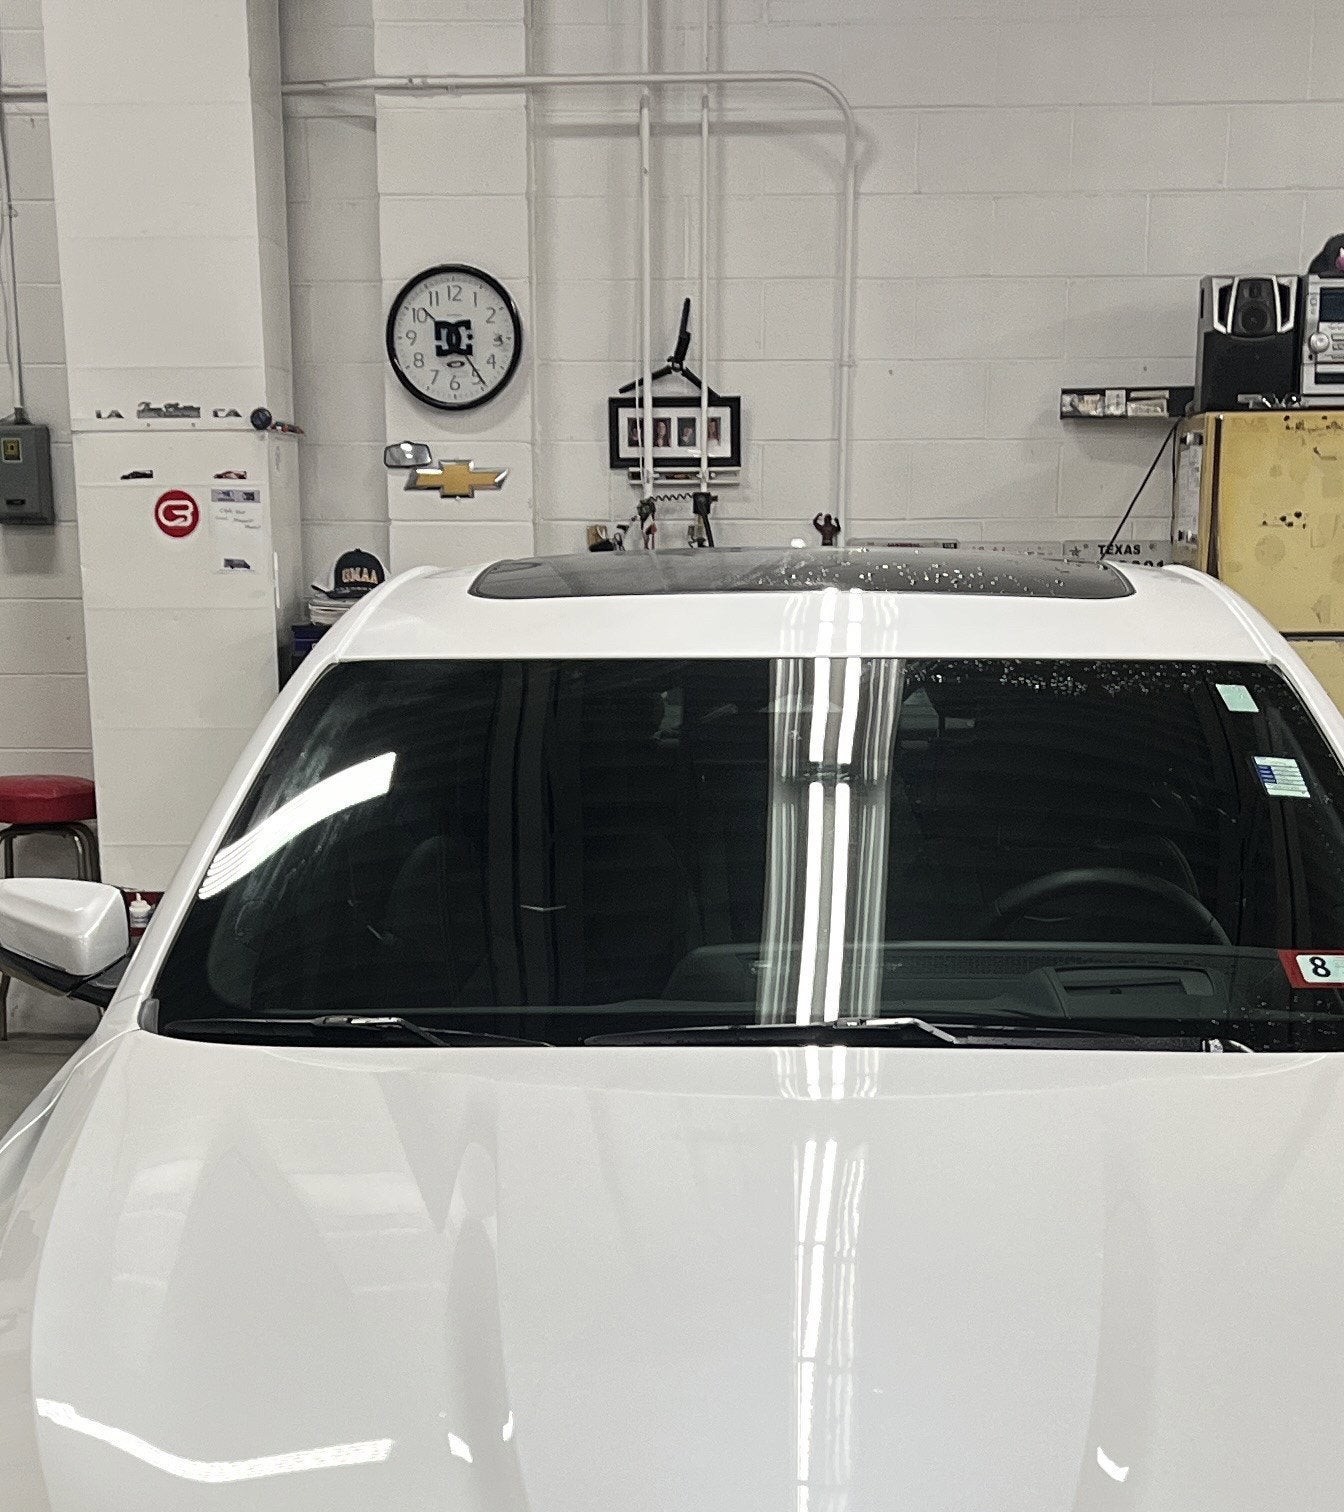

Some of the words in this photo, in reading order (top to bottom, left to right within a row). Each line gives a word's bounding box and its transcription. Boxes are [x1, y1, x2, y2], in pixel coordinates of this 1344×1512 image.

[429, 290, 440, 307] 11
[447, 285, 463, 302] 12
[472, 291, 478, 307] 1
[412, 307, 428, 323] 10
[485, 306, 497, 324] 2
[405, 329, 418, 346] 9
[413, 352, 425, 368] 8
[486, 353, 497, 370] 4
[430, 369, 440, 385] 7
[449, 375, 461, 391] 6
[1097, 543, 1141, 555] TEXAS
[1309, 956, 1331, 978] 8
